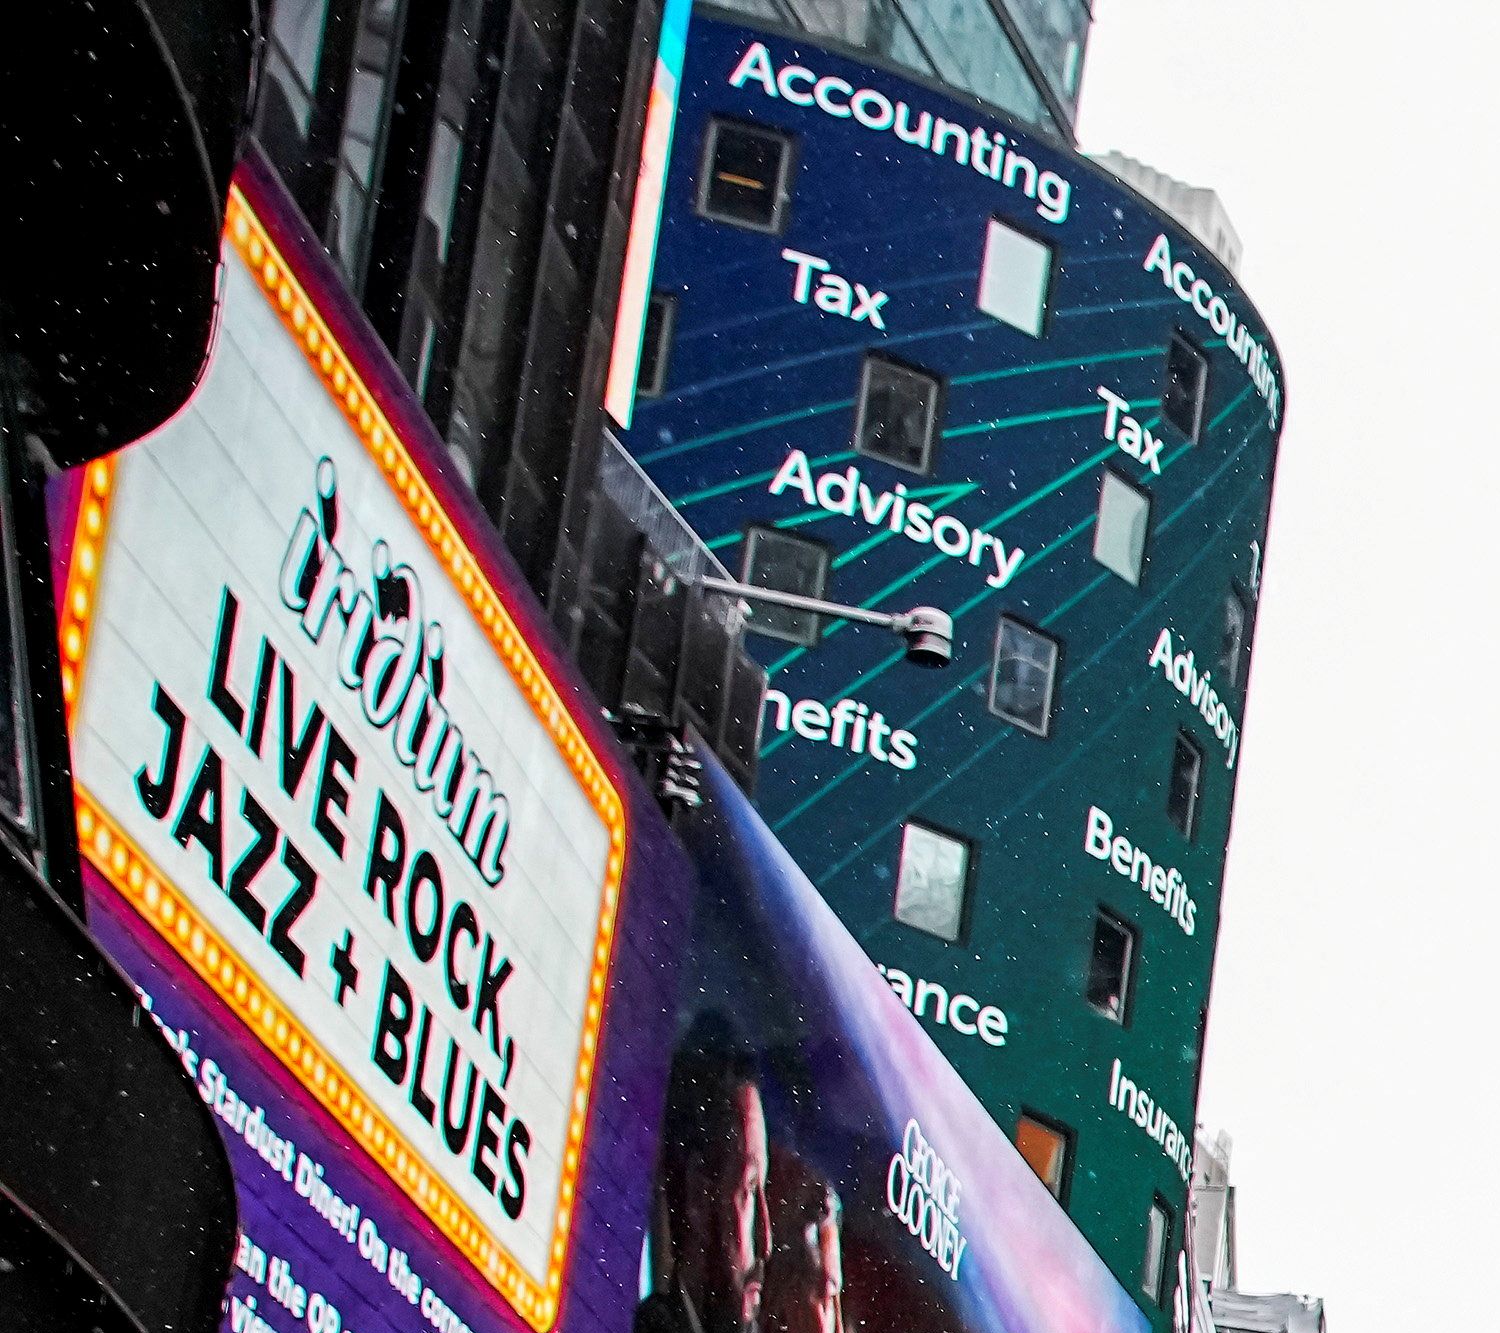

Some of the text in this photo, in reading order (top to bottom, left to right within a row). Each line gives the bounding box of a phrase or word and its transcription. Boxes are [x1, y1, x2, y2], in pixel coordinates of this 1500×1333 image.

[730, 41, 1072, 224] Accounting
[782, 247, 890, 332] Tax
[1144, 233, 1282, 431] Accounting
[1097, 385, 1165, 476] Tax
[769, 449, 1025, 588] Advisory
[765, 686, 919, 770] nefits
[1148, 627, 1239, 770] Advisory
[207, 585, 516, 1092] LIVE ROCK,
[1085, 805, 1196, 936] Benefits
[133, 681, 319, 981] JAZZ
[329, 927, 362, 1008] +
[371, 960, 532, 1222] BLUES
[200, 1057, 295, 1182] Stardust
[295, 1151, 360, 1244] Diner!
[358, 1218, 389, 1273] On
[388, 1247, 422, 1304] the
[887, 1152, 966, 1280] CLOONEY
[903, 1118, 962, 1225] GEORGE
[267, 1256, 308, 1318] the
